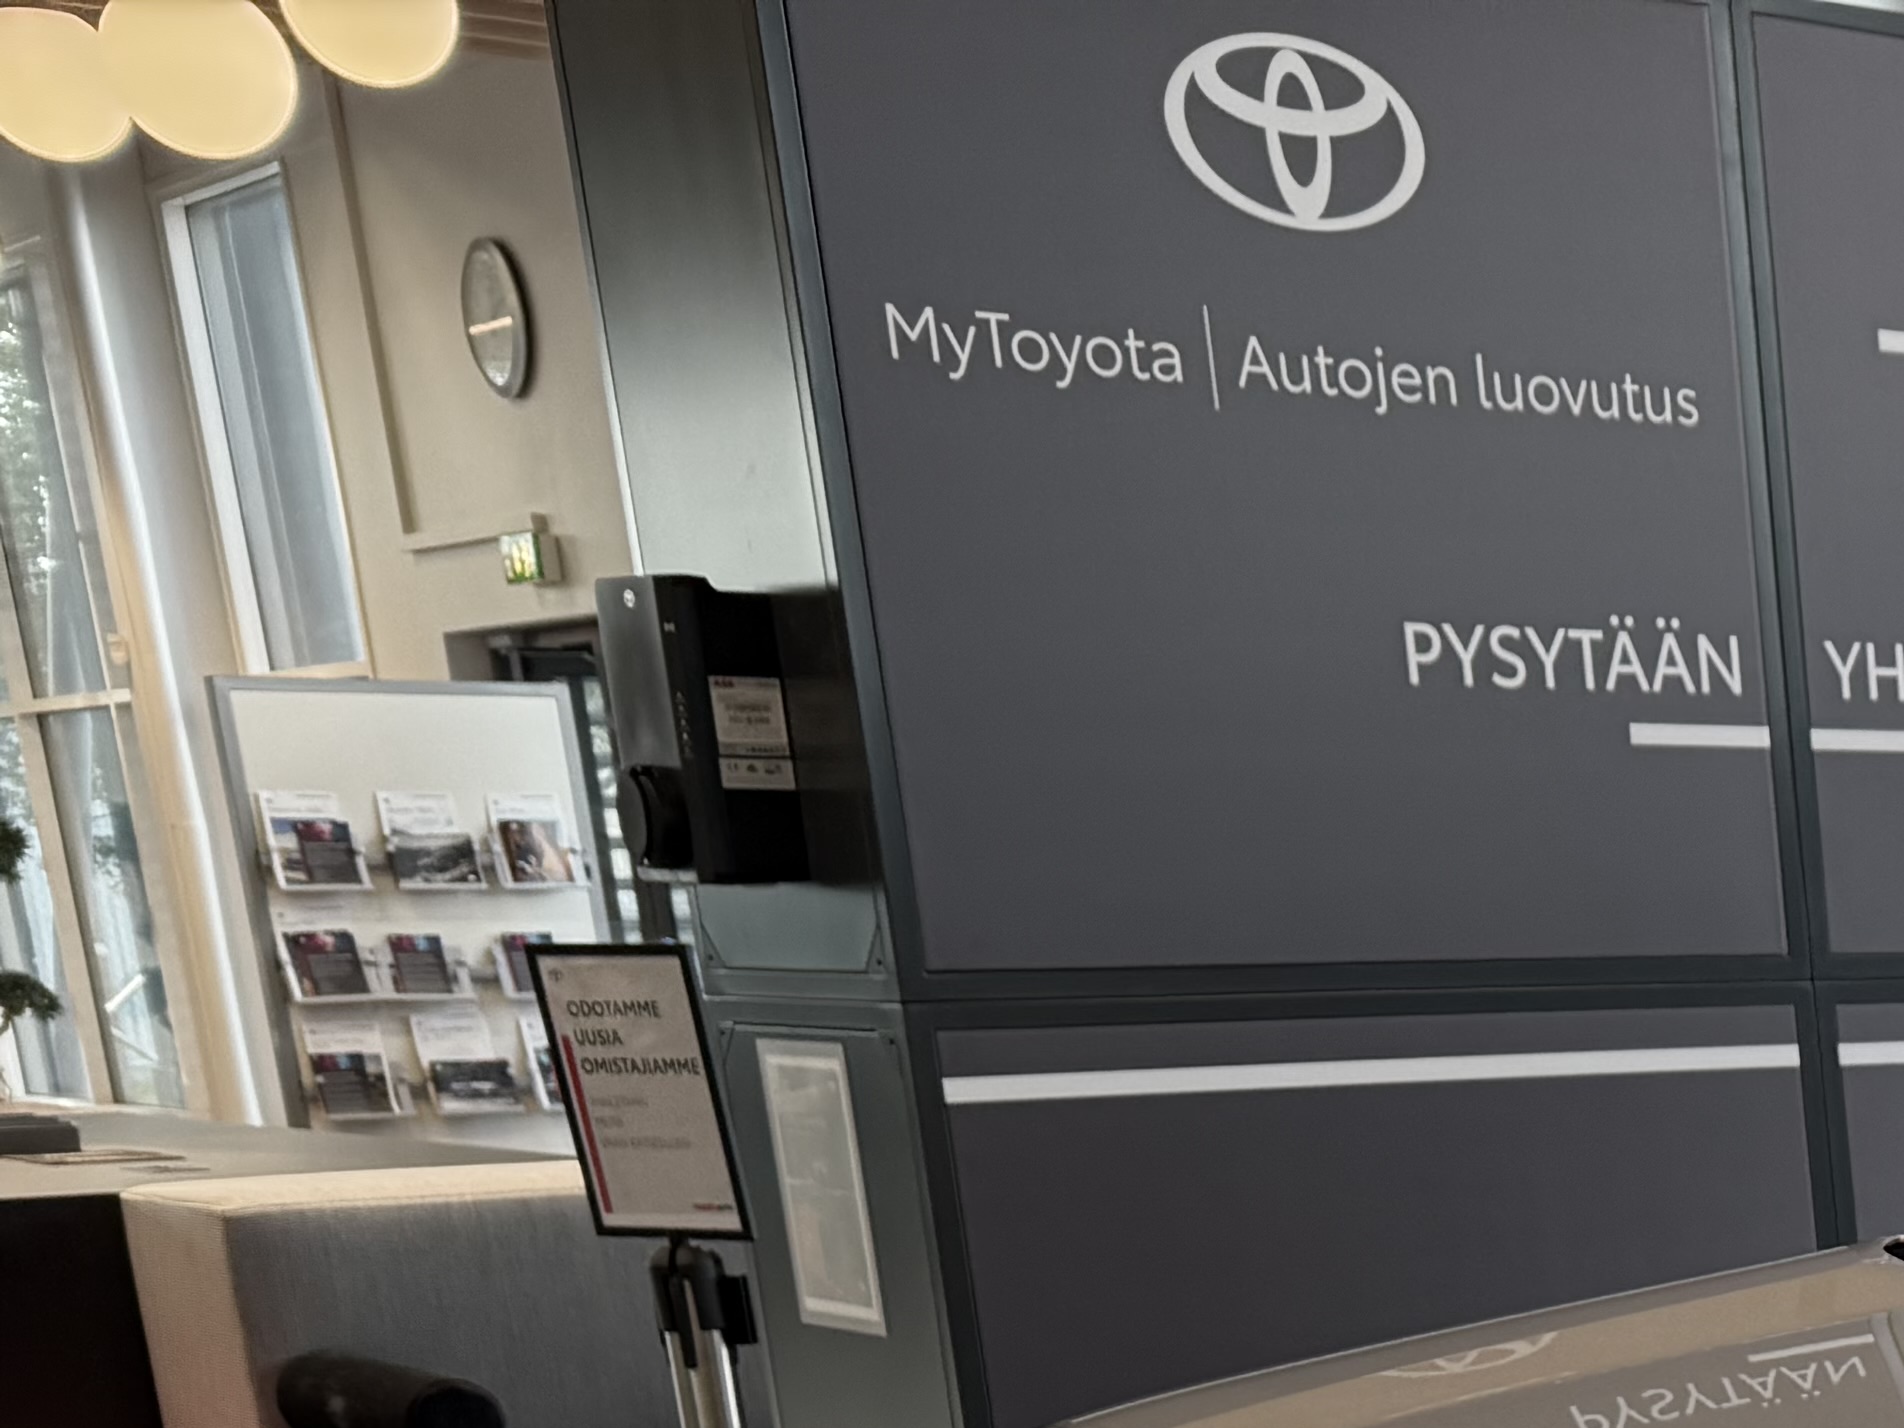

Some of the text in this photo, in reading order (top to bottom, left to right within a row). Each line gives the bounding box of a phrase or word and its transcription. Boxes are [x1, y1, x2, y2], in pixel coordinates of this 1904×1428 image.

[884, 302, 1700, 426] MyToyota Autojen luovutus
[1404, 615, 1742, 696] PYSYTÄÄN
[566, 1000, 661, 1019] ODOTAMME
[573, 1028, 624, 1047] UUSIA
[580, 1057, 700, 1075] OMISTAJIAMME
